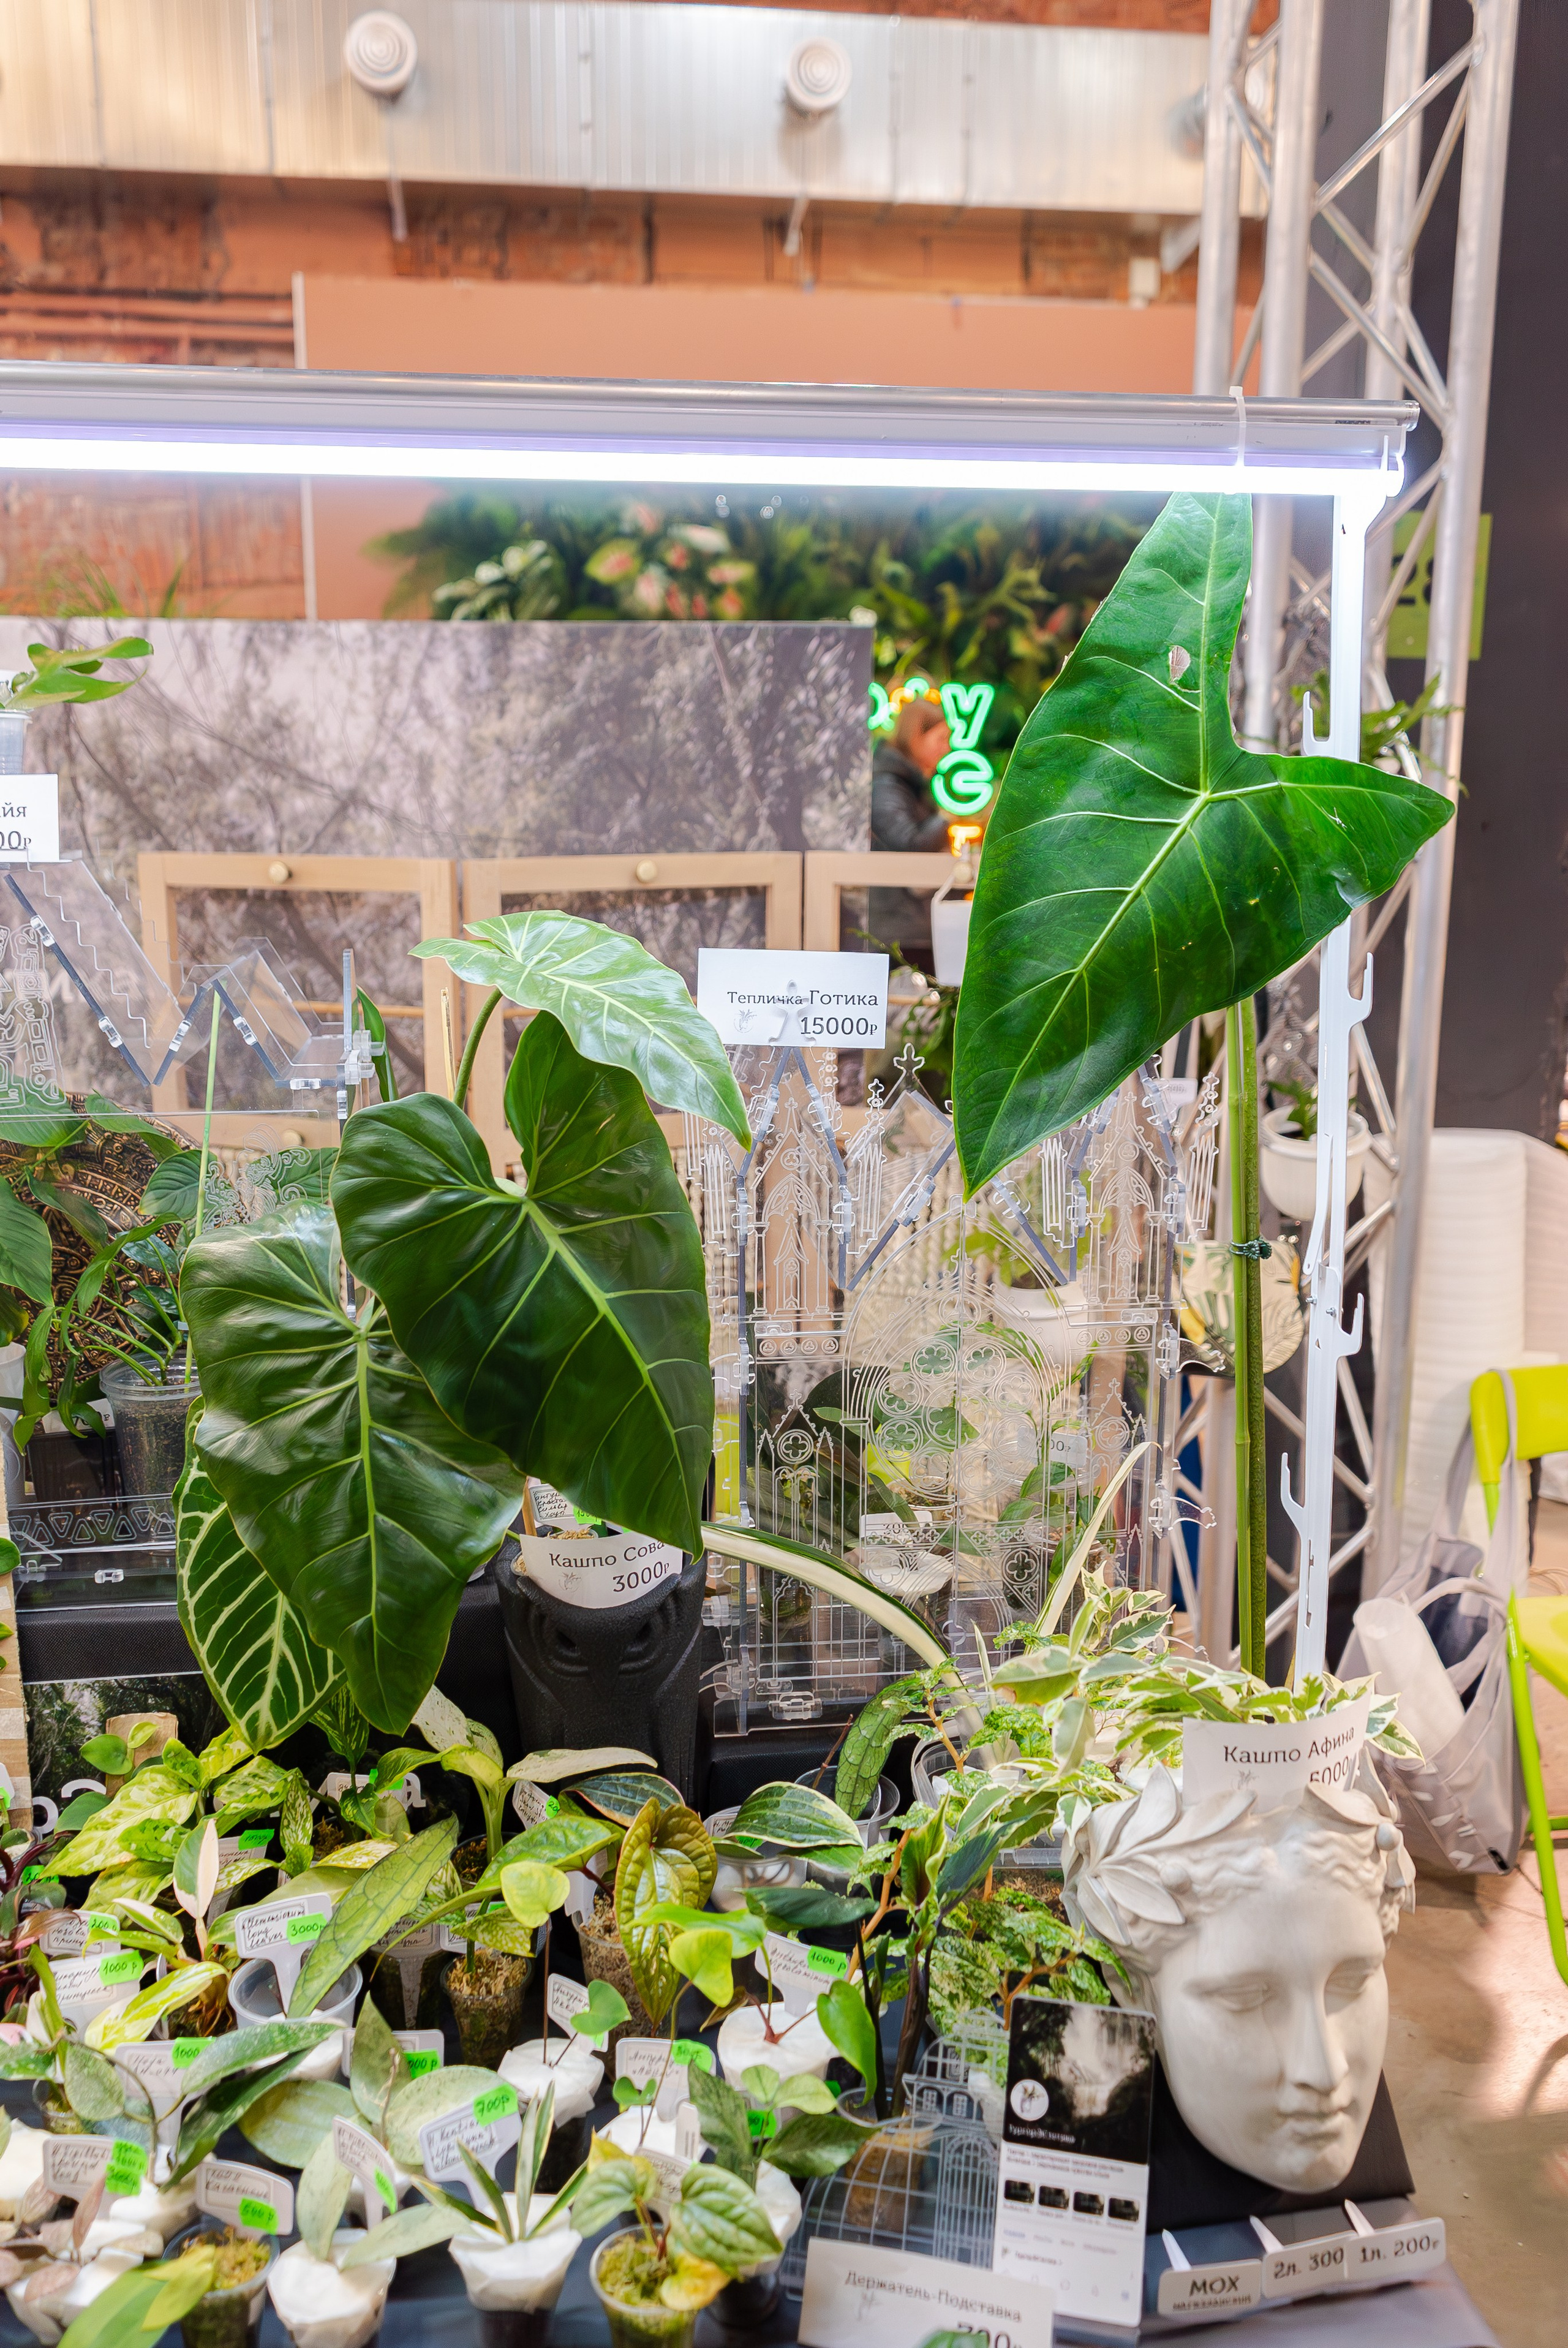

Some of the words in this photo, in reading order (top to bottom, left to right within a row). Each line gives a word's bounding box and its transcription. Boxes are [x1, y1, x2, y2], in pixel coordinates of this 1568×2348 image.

[0, 802, 28, 818] йя
[727, 991, 803, 1006] Тепличка
[809, 990, 878, 1006] Готика
[549, 1553, 617, 1568] Кашпо
[623, 1541, 665, 1561] Сова
[1223, 1745, 1301, 1764] Кашпо
[1308, 1726, 1355, 1759] Афина
